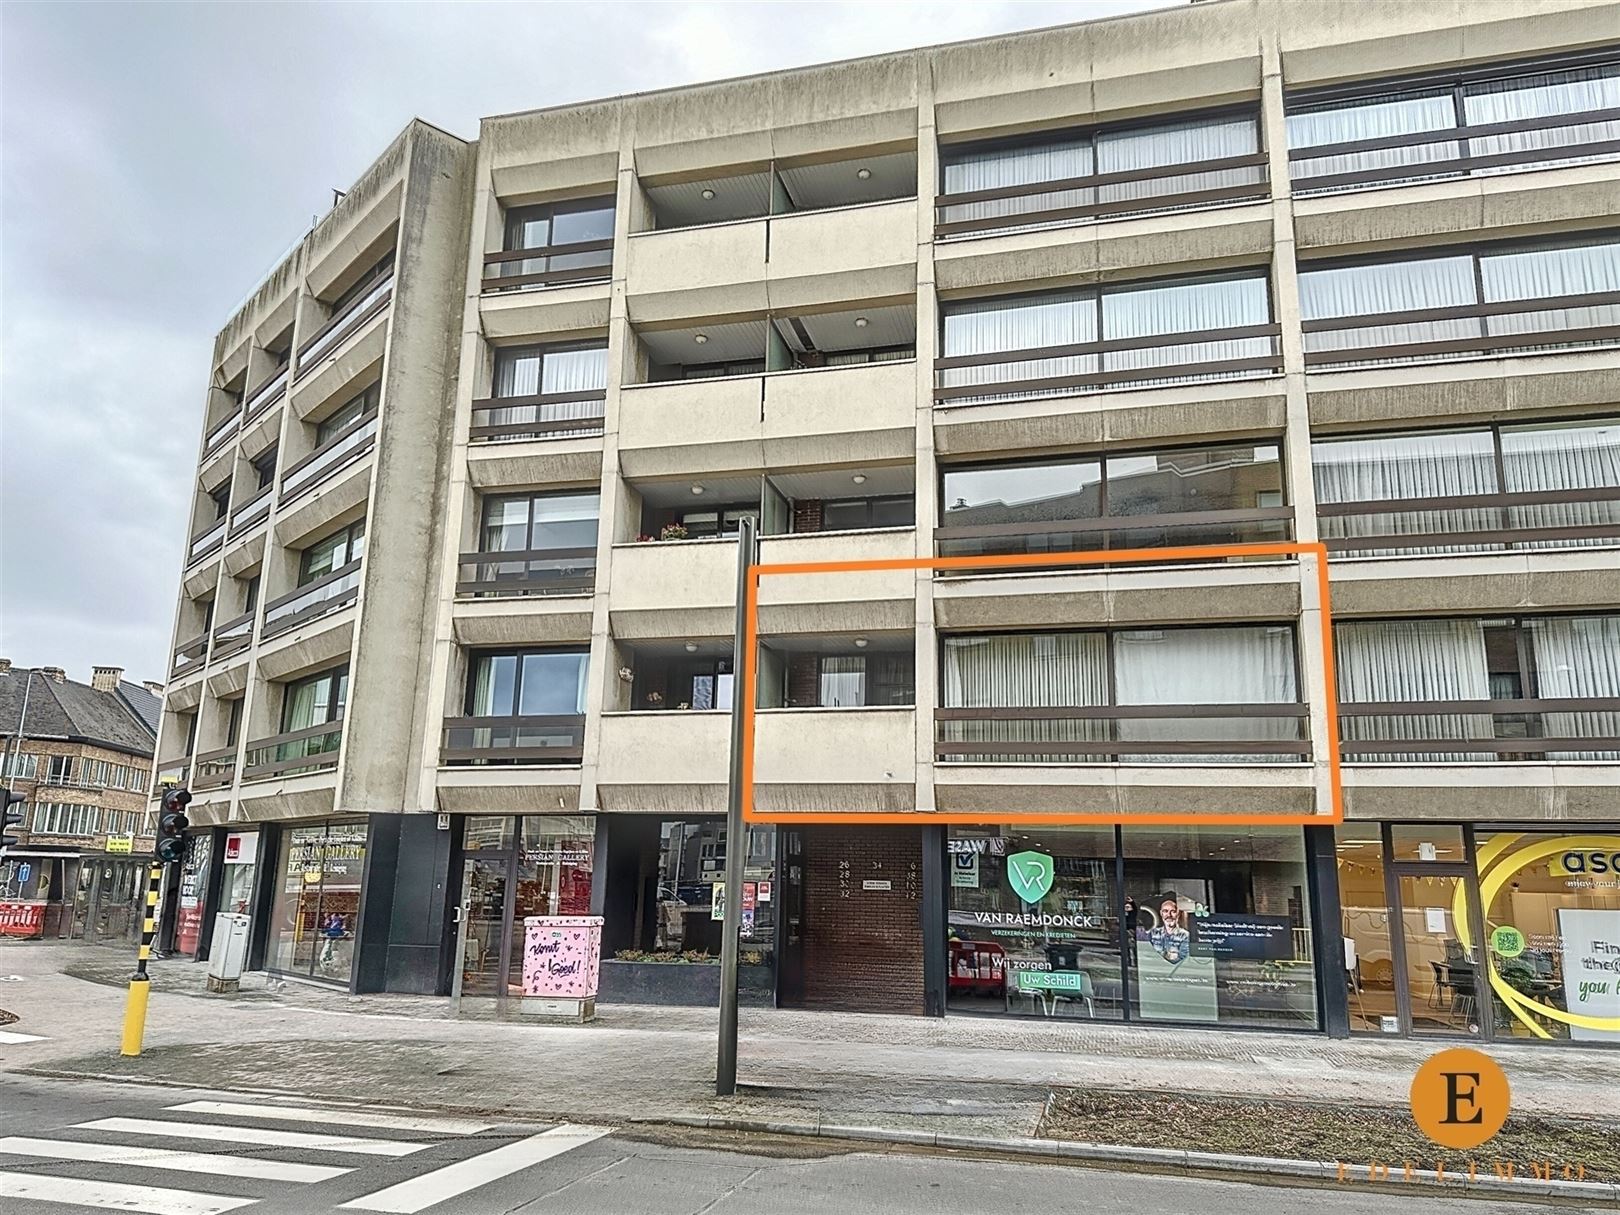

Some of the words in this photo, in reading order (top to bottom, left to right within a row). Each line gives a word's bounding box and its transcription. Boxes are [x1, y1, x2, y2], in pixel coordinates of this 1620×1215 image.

[839, 861, 849, 869] 26
[840, 870, 850, 878] 28
[974, 912, 1001, 924] VAN
[1006, 913, 1092, 927] RAEMDONCK
[992, 957, 1010, 970] Wij
[1013, 960, 1052, 971] zorgen
[1023, 974, 1041, 985] Uw
[1044, 975, 1076, 986] Schild
[1579, 981, 1608, 1001] you
